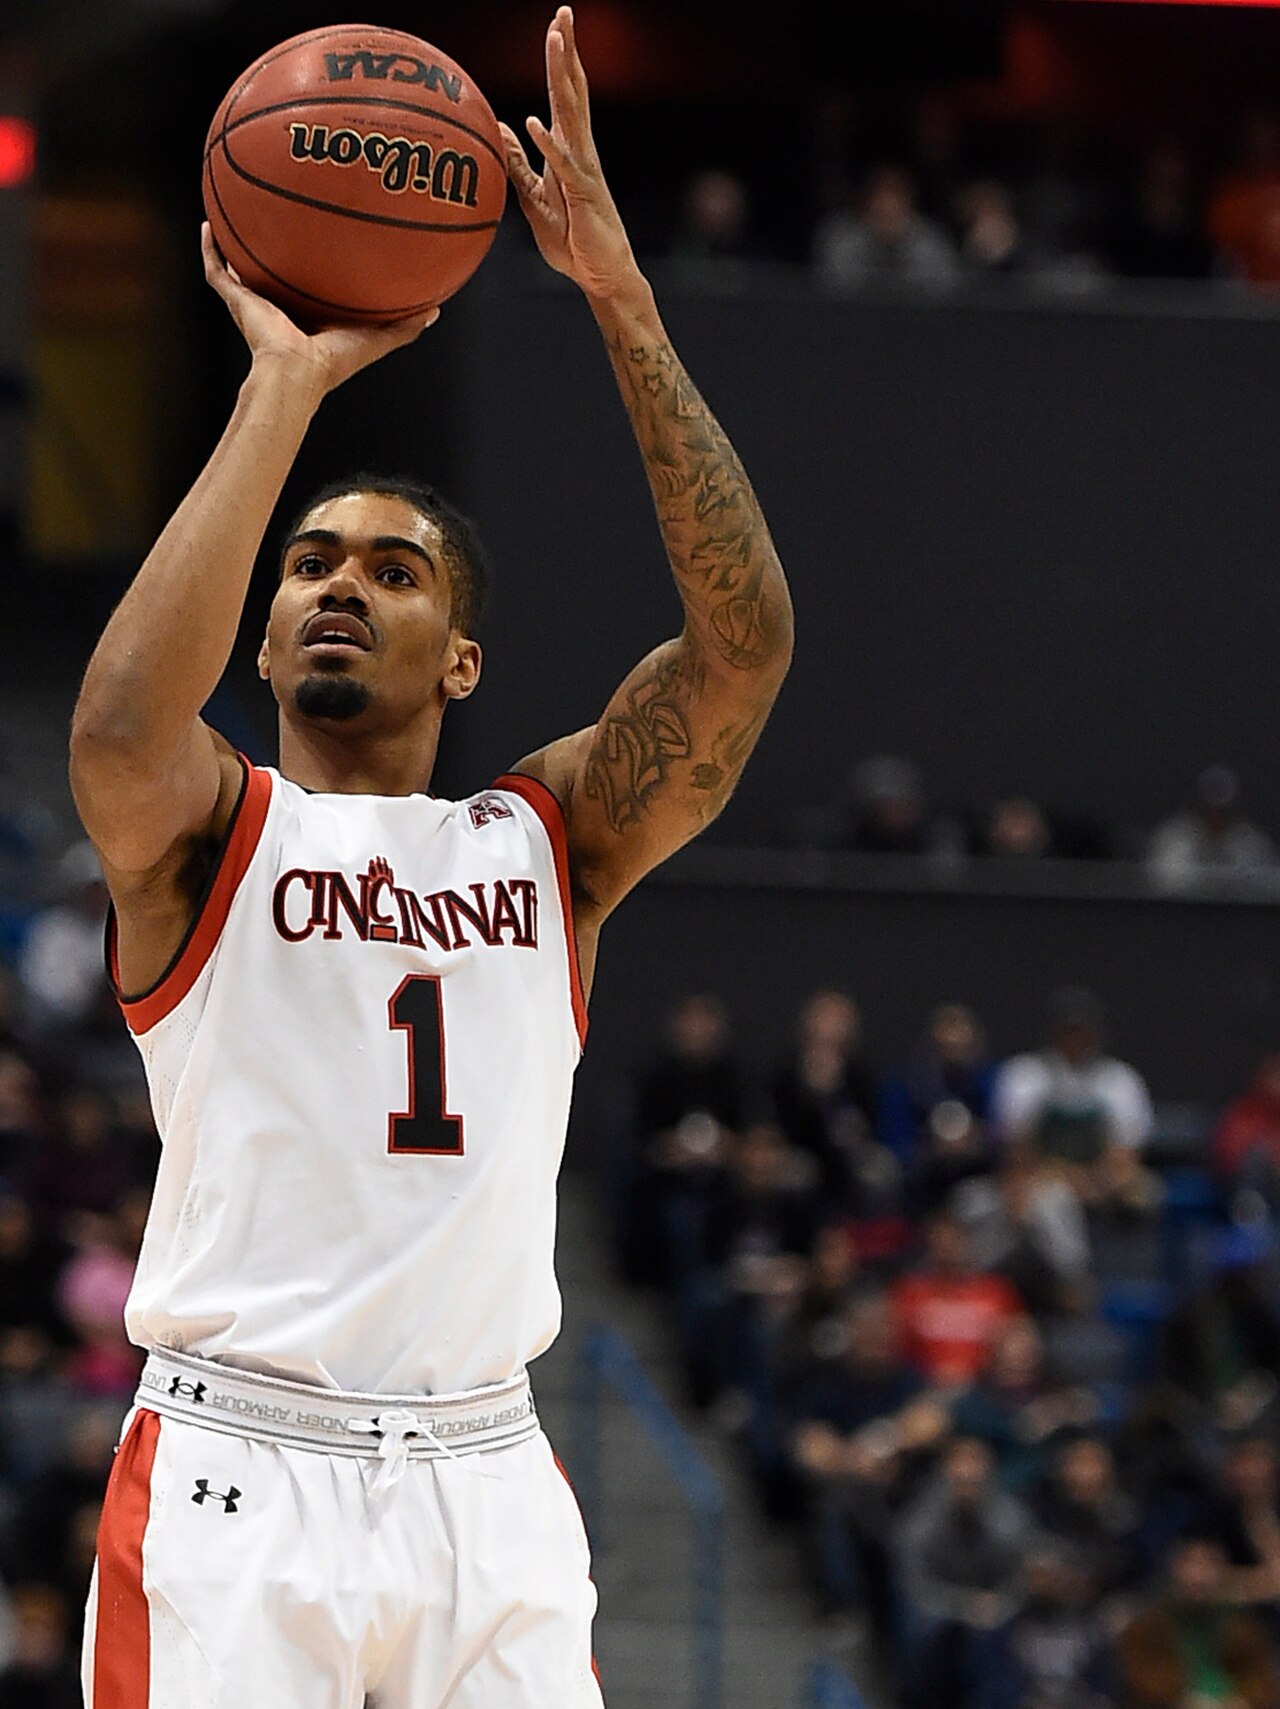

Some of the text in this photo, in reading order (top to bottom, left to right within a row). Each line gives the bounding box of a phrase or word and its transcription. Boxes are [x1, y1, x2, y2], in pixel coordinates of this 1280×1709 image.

[323, 50, 462, 103] NCAA
[289, 122, 479, 208] Wilson
[388, 973, 464, 1155] 1
[213, 1392, 355, 1432] NDER ARMOUR
